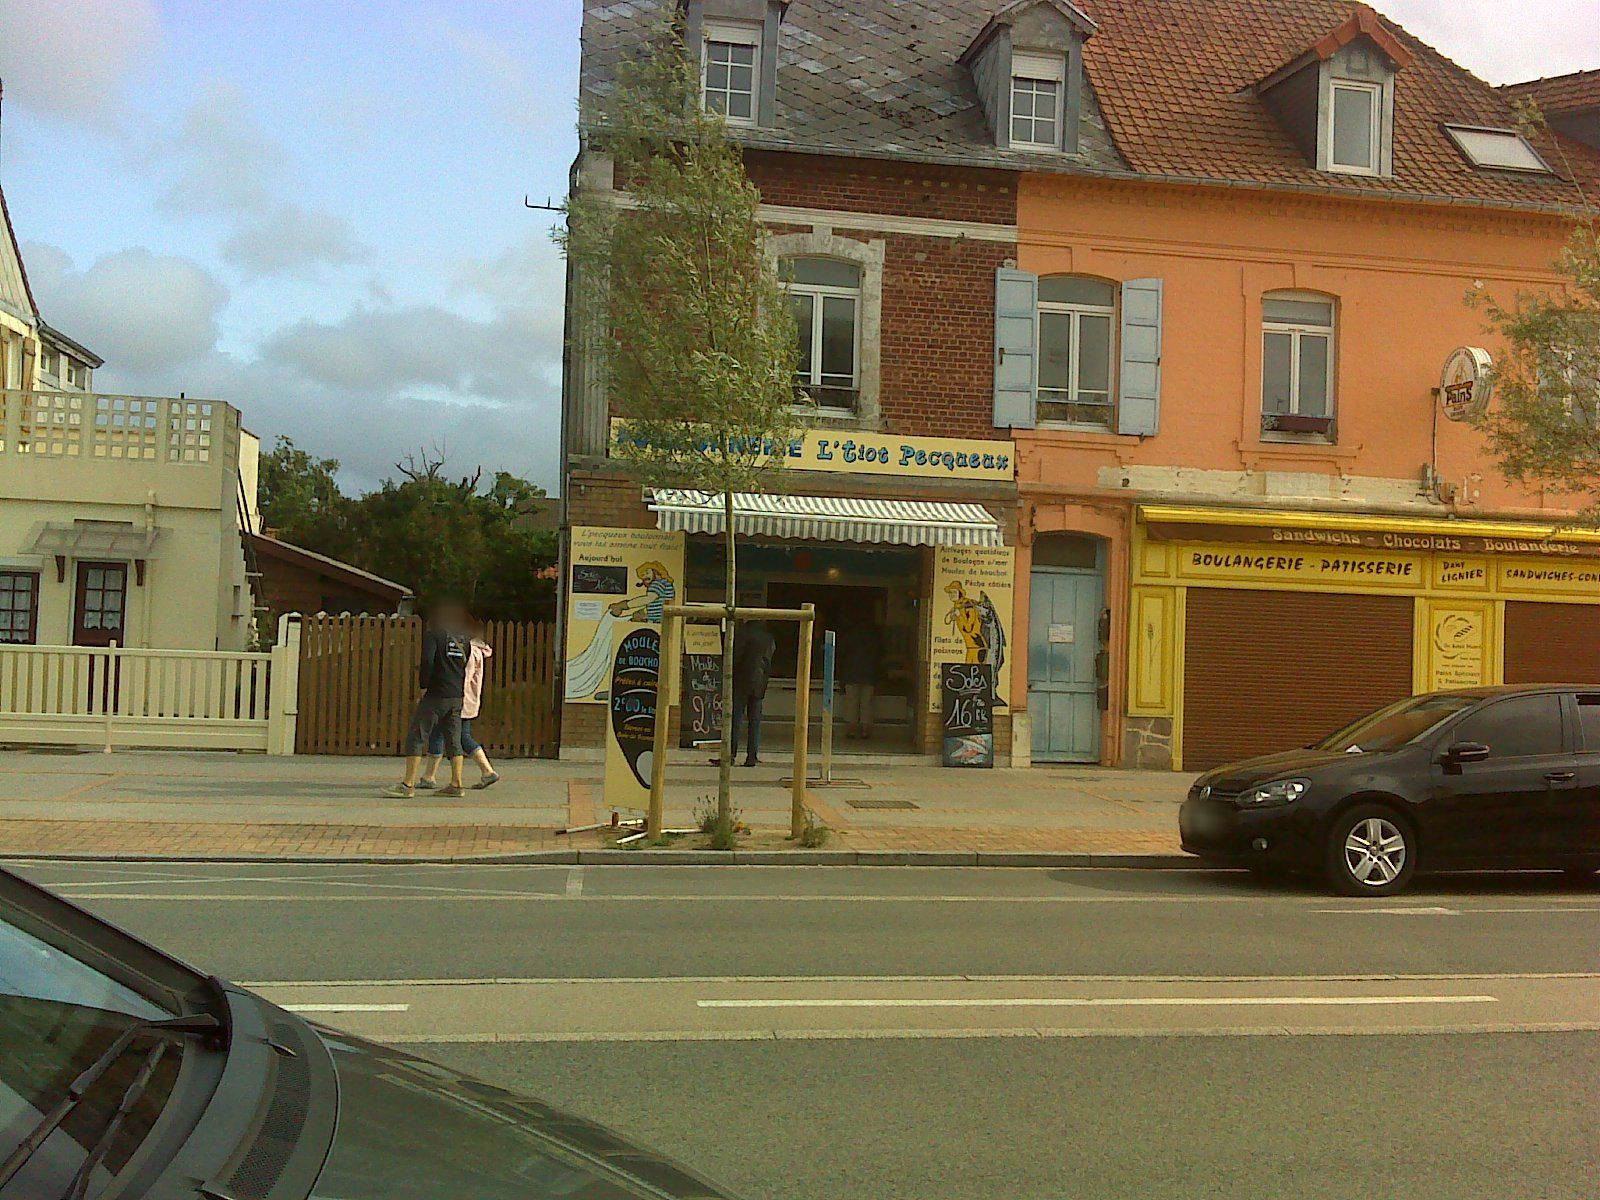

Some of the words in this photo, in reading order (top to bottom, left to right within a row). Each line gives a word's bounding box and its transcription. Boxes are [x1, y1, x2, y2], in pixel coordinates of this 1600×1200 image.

[1446, 388, 1473, 405] Pains
[898, 445, 1009, 472] Pecqueux
[1272, 528, 1361, 545] Sandwichs
[1383, 534, 1461, 550] Chocolats
[1483, 538, 1579, 554] Boulangerie
[1192, 553, 1304, 570] BOULANGERIE
[1321, 559, 1413, 576] PATISSERIE
[1441, 569, 1484, 583] LIGNIER
[628, 656, 659, 668] BOUCHO
[945, 665, 988, 692] Soles
